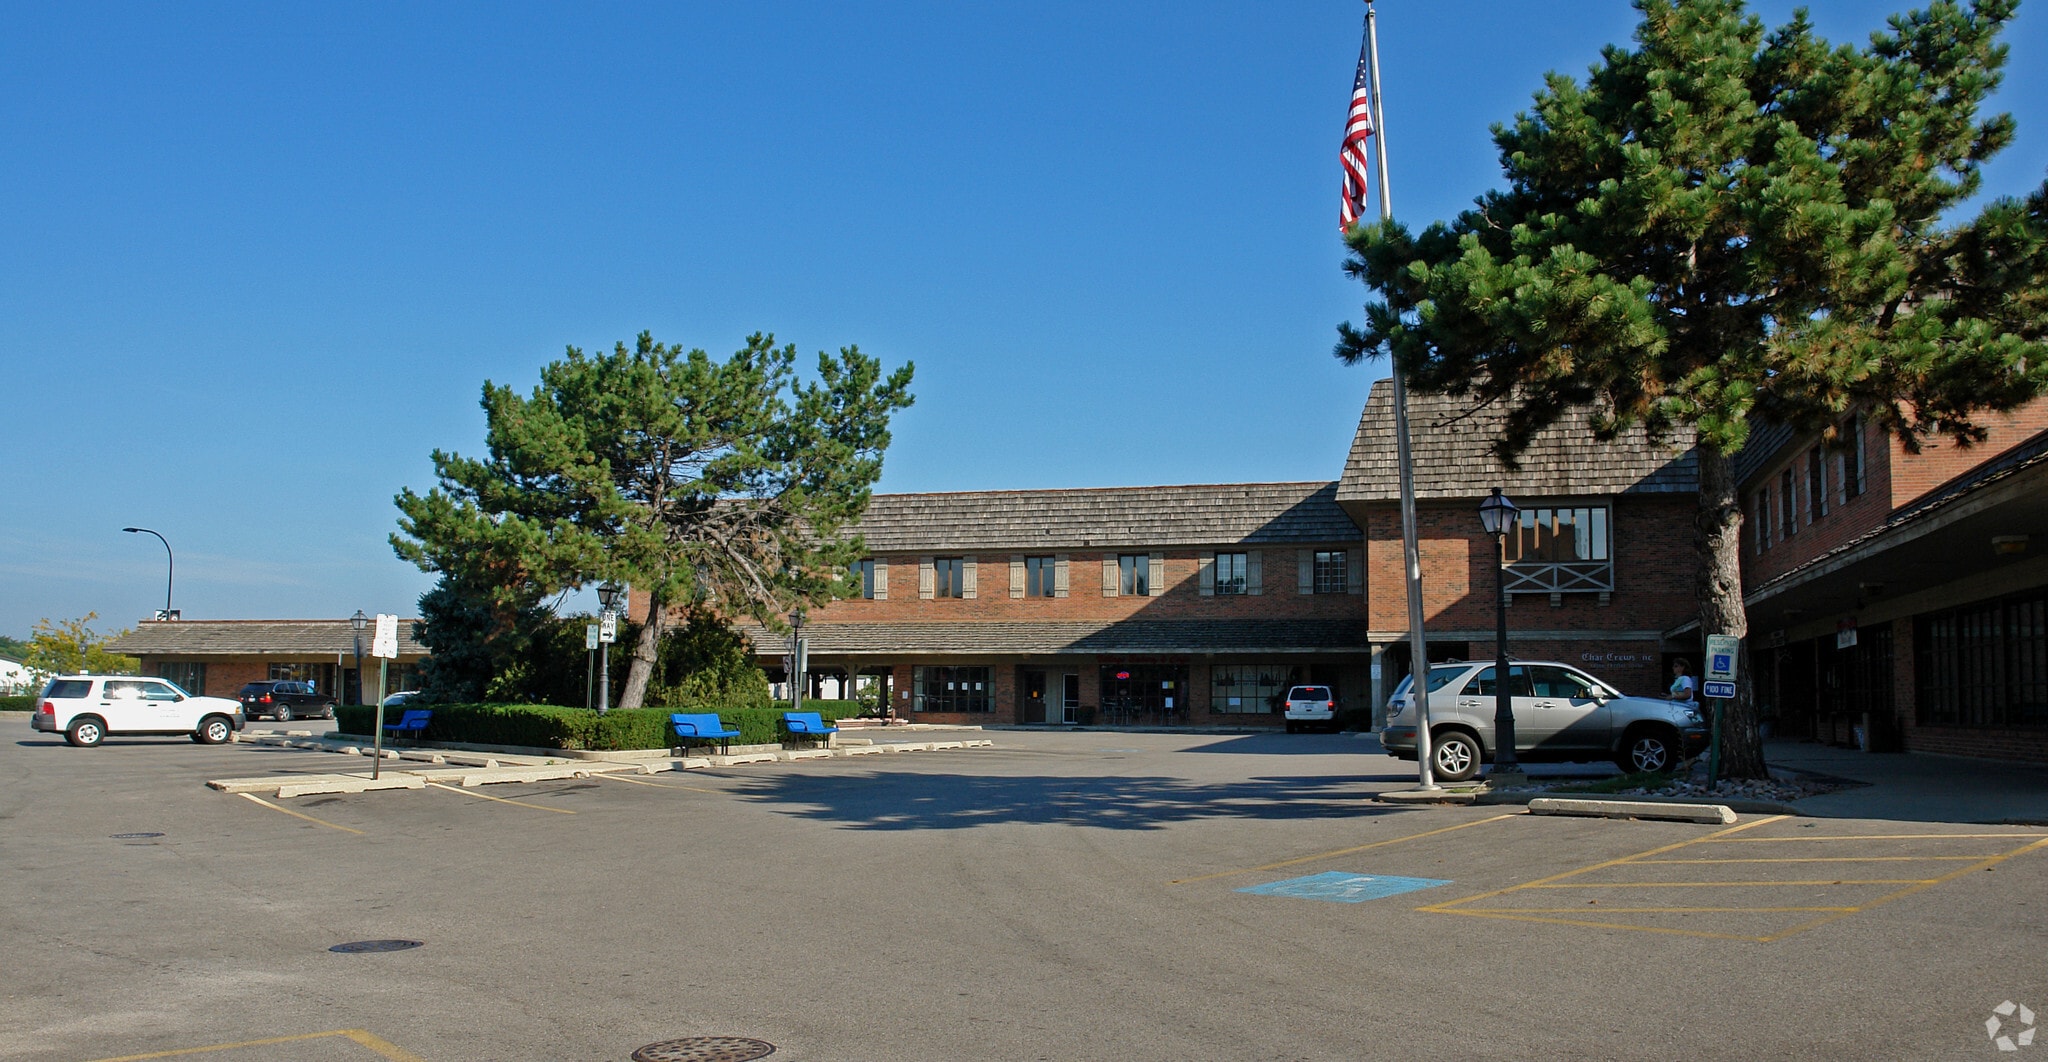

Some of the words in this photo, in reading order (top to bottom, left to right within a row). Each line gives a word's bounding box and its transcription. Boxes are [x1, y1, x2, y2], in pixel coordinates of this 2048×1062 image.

[602, 613, 614, 622] ONE
[1711, 647, 1735, 655] PARKING
[1581, 652, 1604, 661] Char
[1606, 652, 1636, 661] Crews
[1706, 685, 1719, 694] $100
[1720, 686, 1734, 695] FINE
